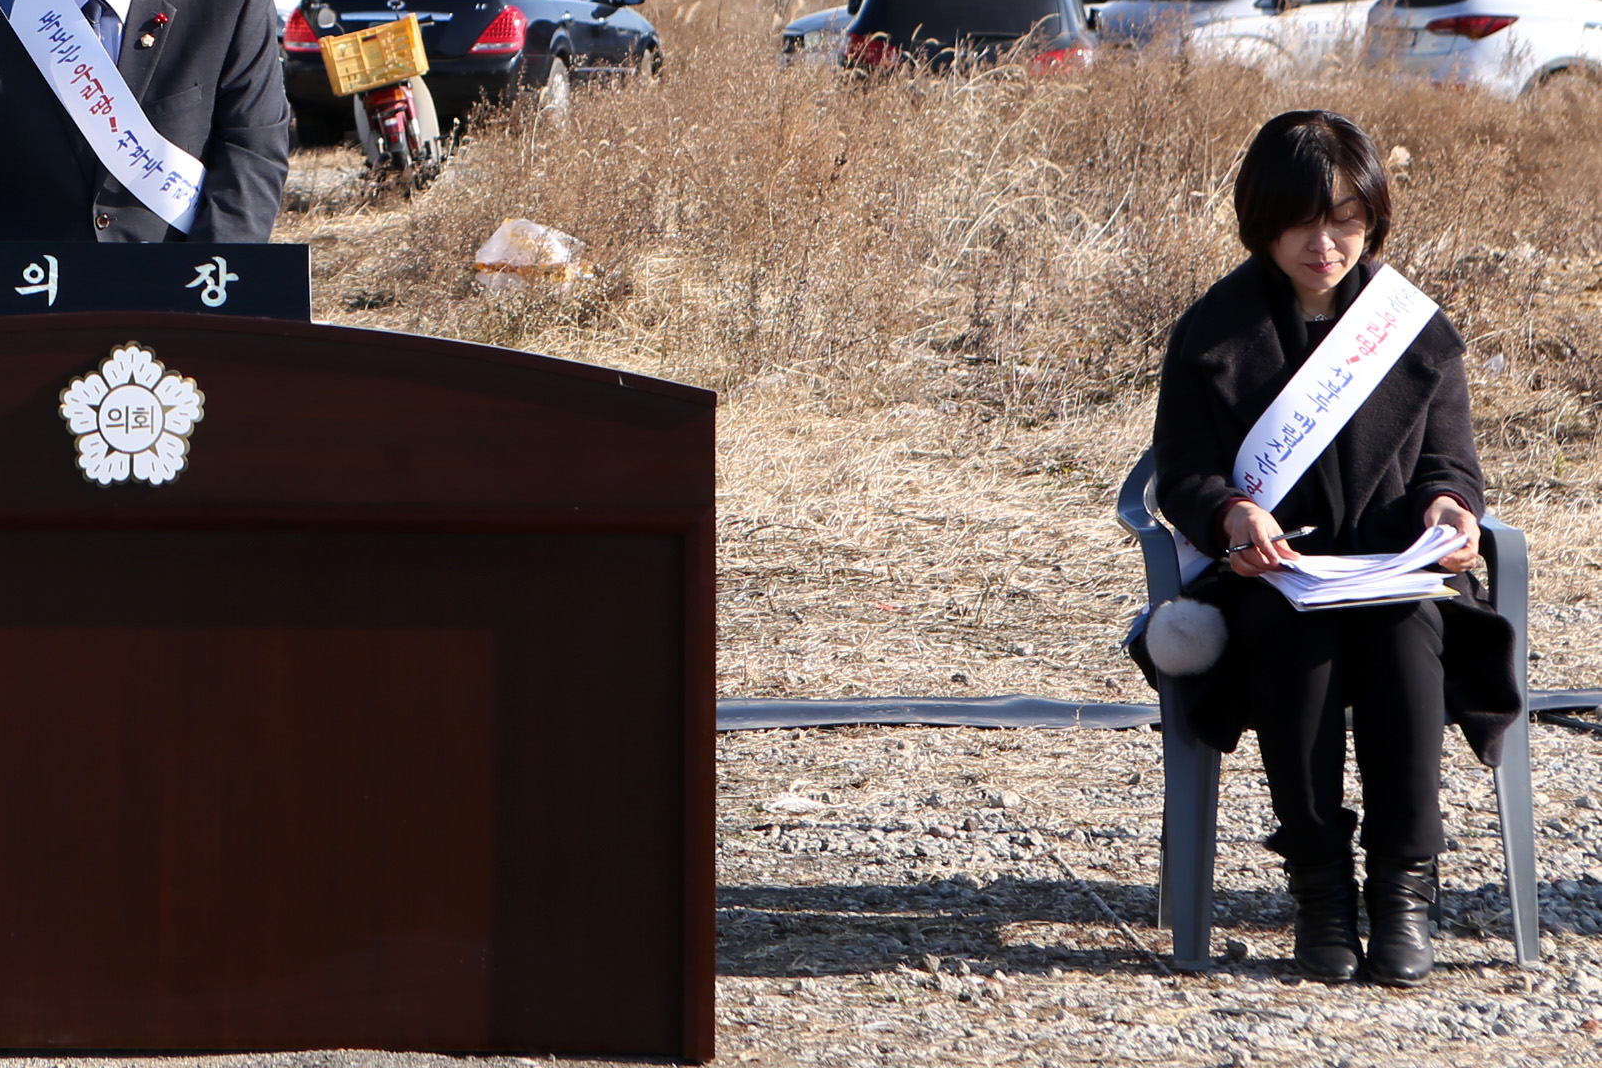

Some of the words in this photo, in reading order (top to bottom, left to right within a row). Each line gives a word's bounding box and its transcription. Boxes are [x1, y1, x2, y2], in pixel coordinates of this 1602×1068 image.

[37, 10, 81, 64] 독도는
[71, 63, 118, 132] 우리땅!
[117, 130, 163, 179] 서부두
[1306, 366, 1353, 414] 서부두
[105, 405, 155, 435] 의회
